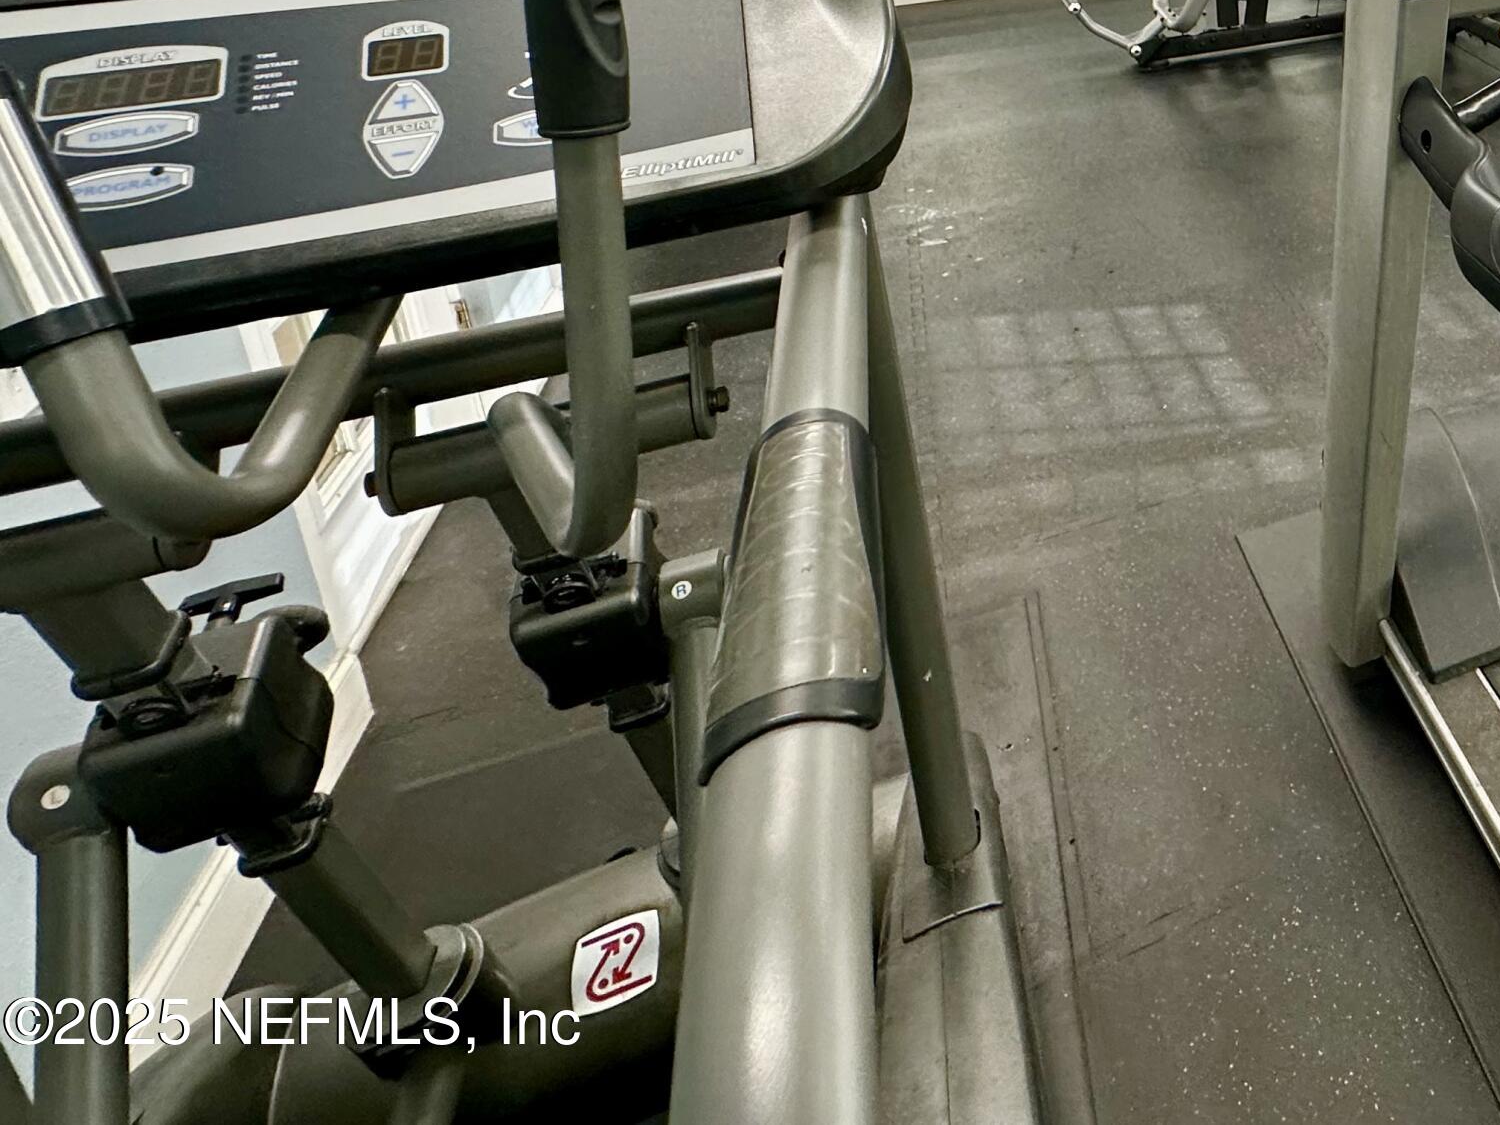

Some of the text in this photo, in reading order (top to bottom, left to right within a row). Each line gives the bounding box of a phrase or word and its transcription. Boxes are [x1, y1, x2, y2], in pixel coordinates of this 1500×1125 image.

[382, 24, 433, 38] LEVEL
[96, 49, 178, 68] DISPLAY
[254, 59, 299, 70] DISTANCE
[254, 71, 283, 80] SPEED
[252, 80, 298, 91] CALORIES
[251, 102, 280, 112] PULSE
[88, 123, 168, 143] DISPLAY
[371, 118, 436, 137] EFFORT
[73, 176, 171, 197] PROGRAM
[676, 584, 687, 597] R
